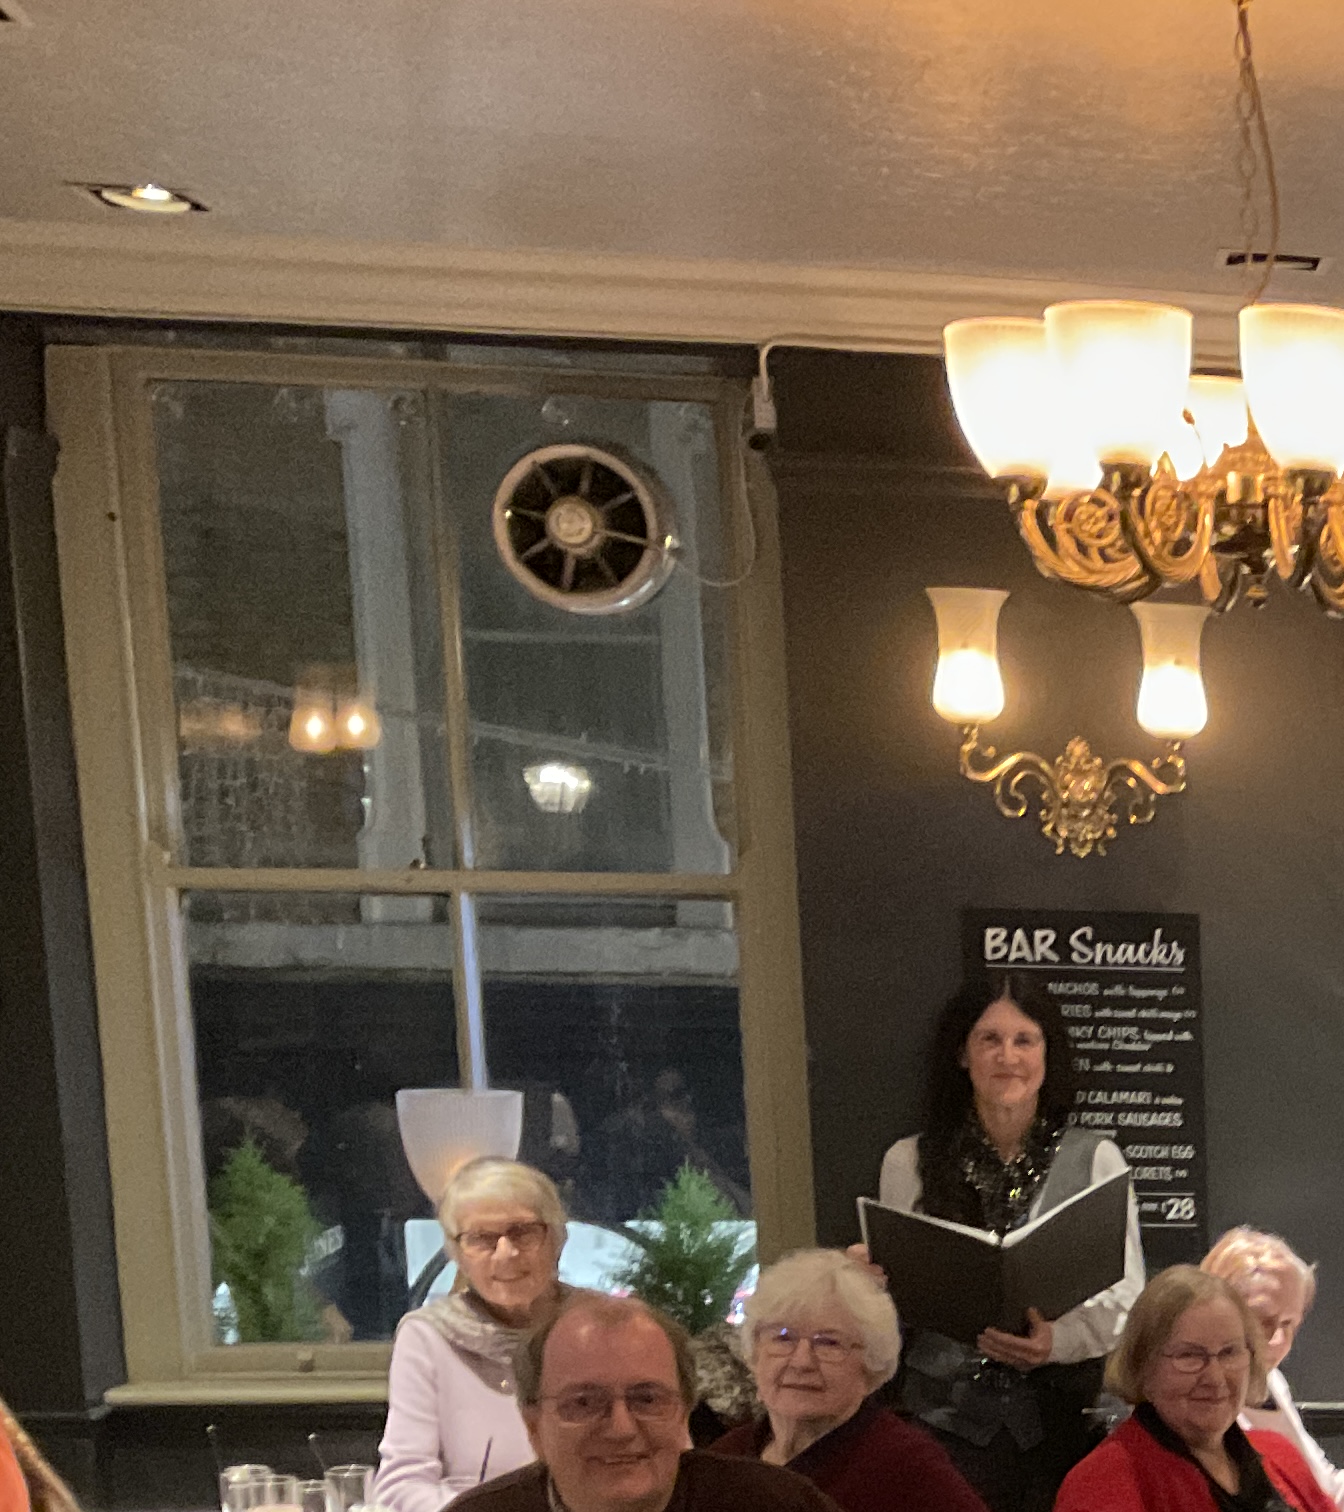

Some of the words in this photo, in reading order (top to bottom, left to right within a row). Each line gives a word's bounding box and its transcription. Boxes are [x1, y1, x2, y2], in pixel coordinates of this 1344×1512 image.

[984, 927, 1060, 962] BAR
[1069, 926, 1185, 965] Snacks
[1048, 982, 1099, 995] NACHOS
[1097, 1025, 1141, 1039] CHIPS
[1088, 1091, 1152, 1104] CALAMARI
[1081, 1112, 1114, 1125] PORK
[1117, 1111, 1183, 1126] SAUSAGES
[1125, 1144, 1169, 1158] SCOTCH
